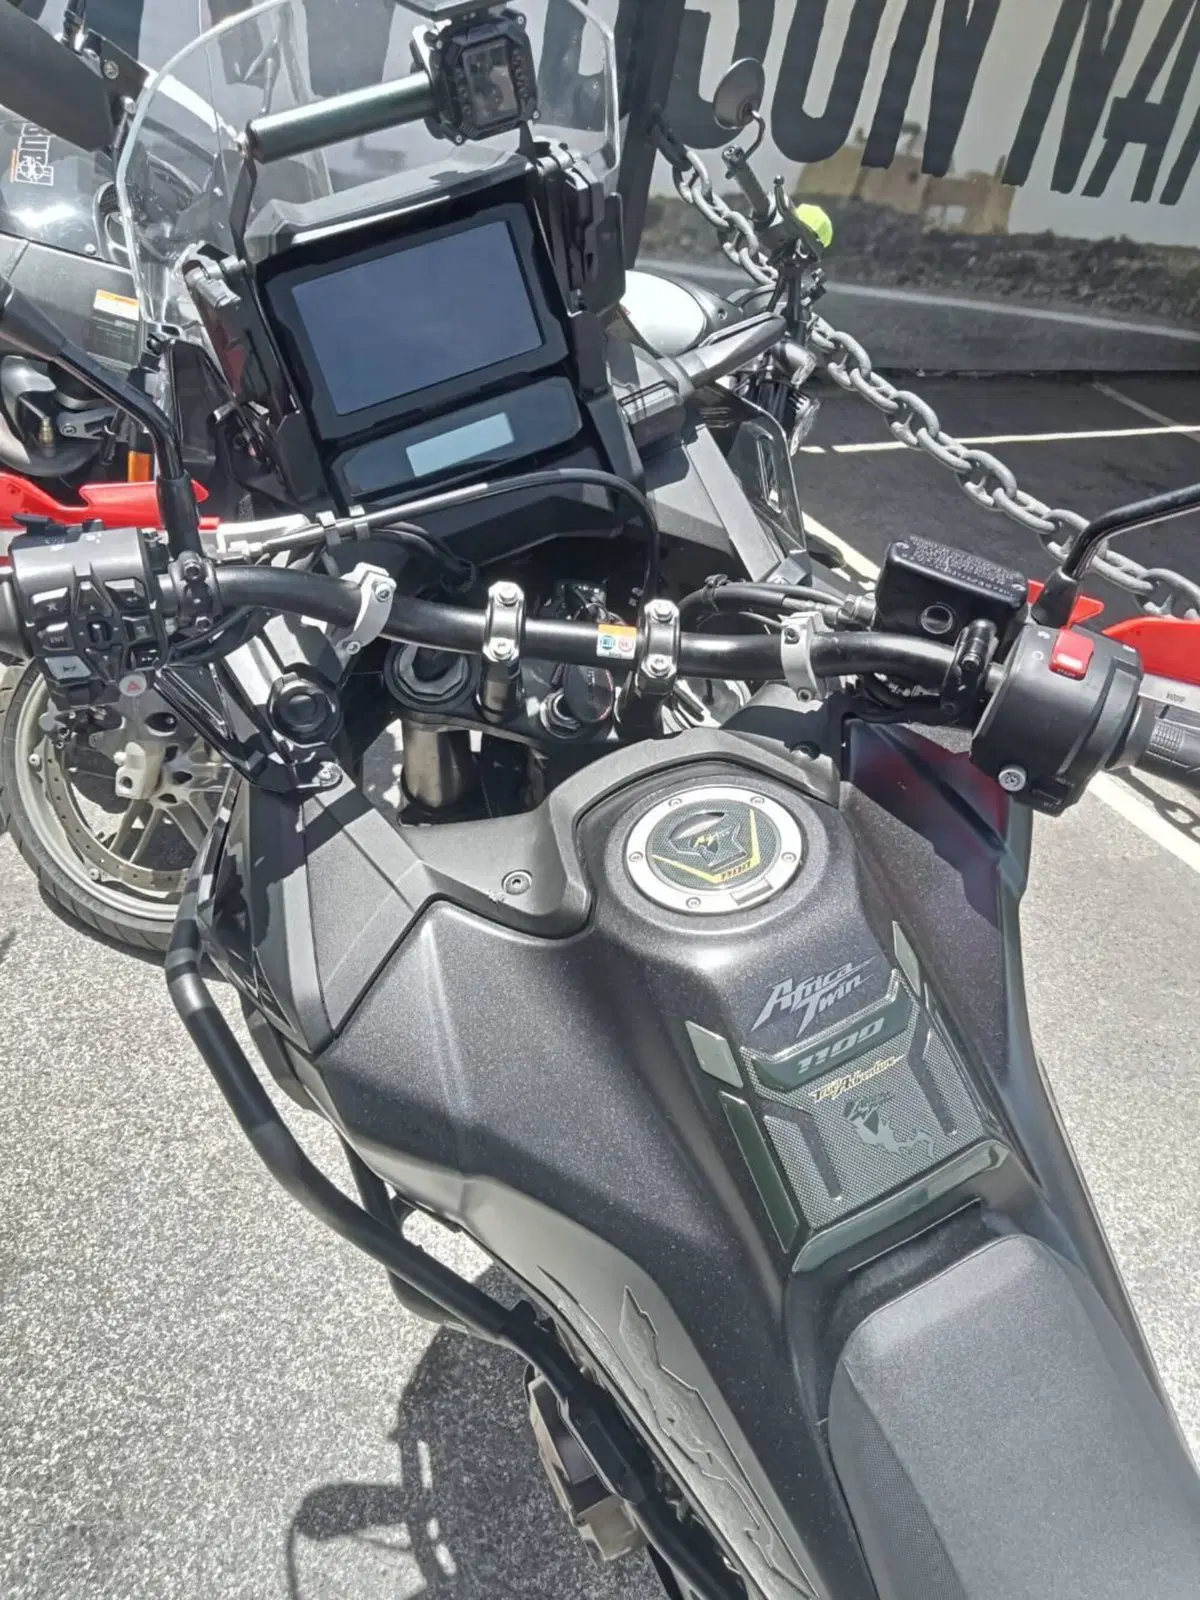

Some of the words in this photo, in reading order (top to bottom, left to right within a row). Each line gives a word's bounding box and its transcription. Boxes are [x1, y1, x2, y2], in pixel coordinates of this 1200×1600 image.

[751, 955, 877, 1032] Africa
[796, 974, 874, 1038] Twin
[798, 1017, 884, 1074] 1100
